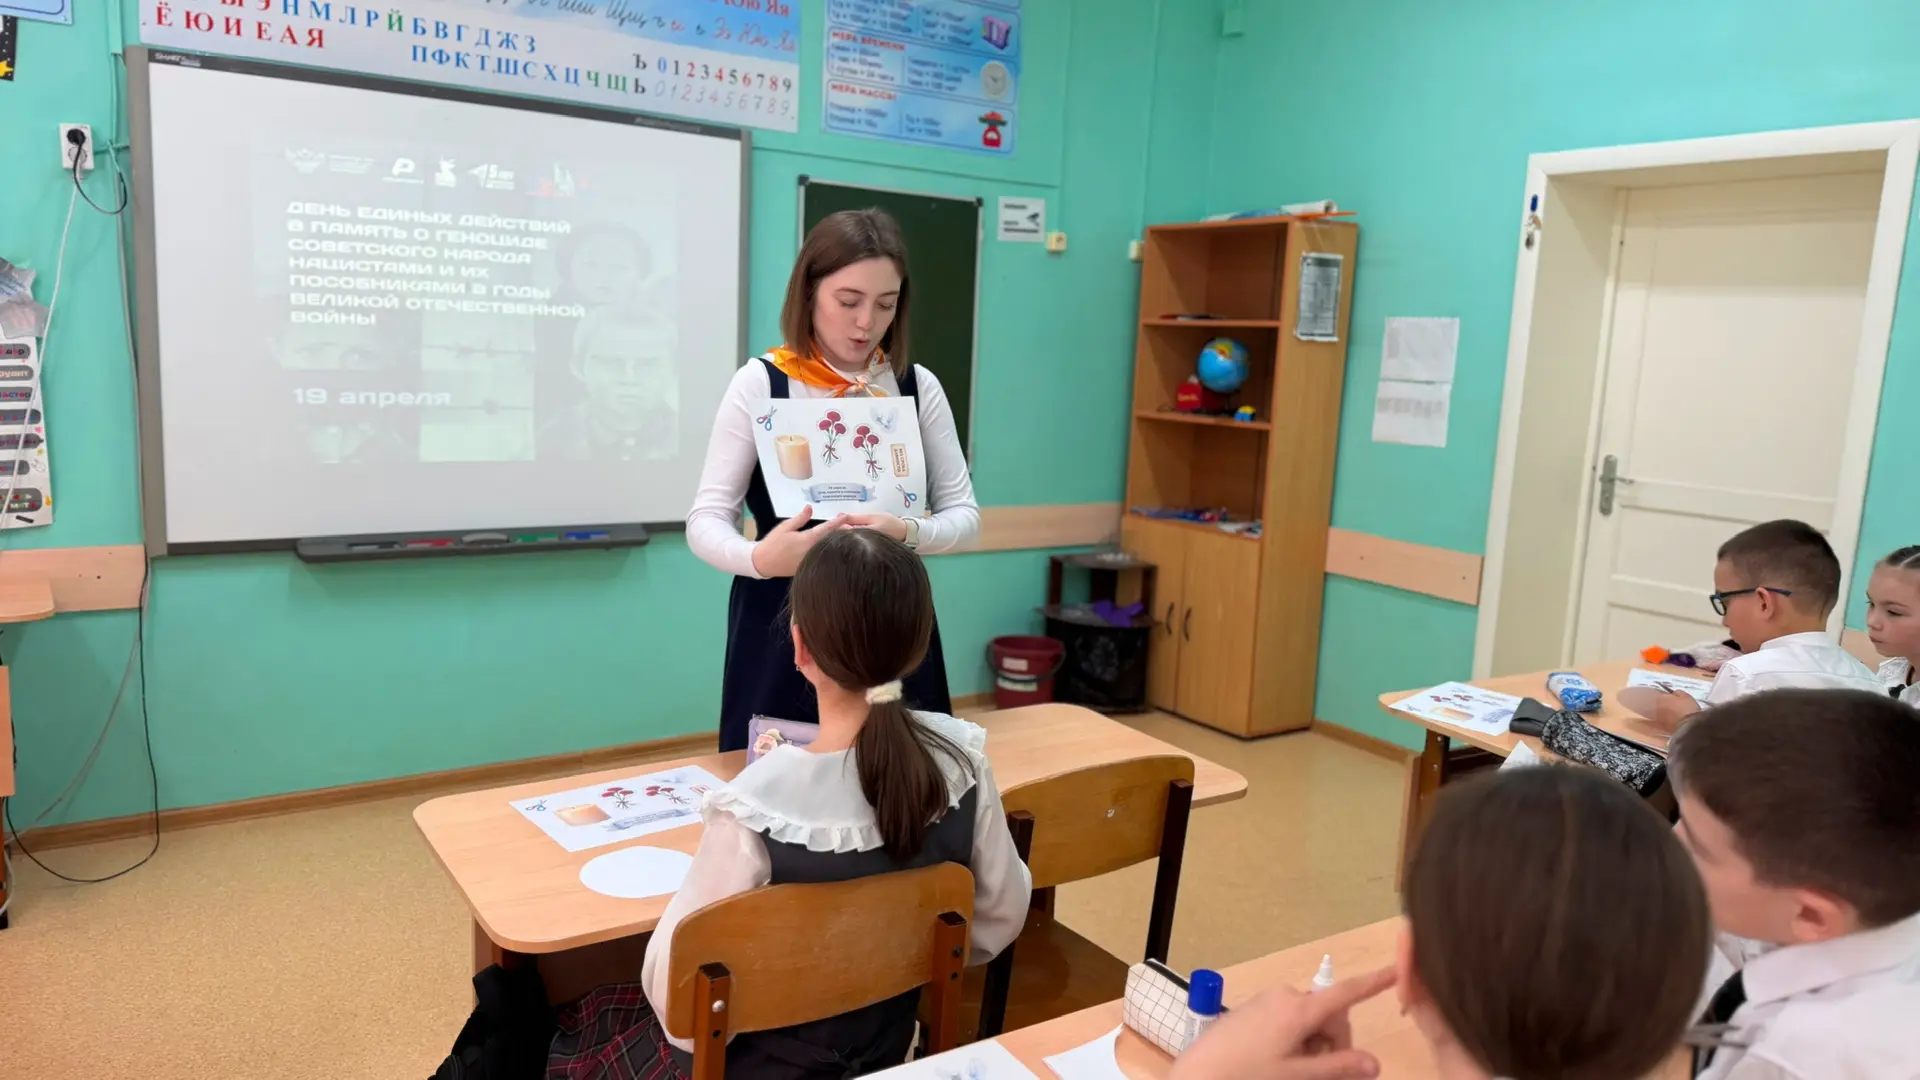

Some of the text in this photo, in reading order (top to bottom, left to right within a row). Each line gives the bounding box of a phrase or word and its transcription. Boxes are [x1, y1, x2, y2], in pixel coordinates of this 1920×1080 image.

[287, 201, 571, 234] ДЕНЬ ЕДИНЫХ ДЕЙСТВИЙ
[287, 219, 549, 249] В ПАМЯТЬ О ГЕНОЦИДЕ
[288, 238, 532, 265] СОВЕТСКОГО НАРОДА
[289, 256, 490, 279] НАЦИСТАМИ И ИХ
[290, 274, 551, 300] ПОСОБНИКАМИ В ГОДЫ
[290, 292, 586, 318] ВЕЛИКОЙ ОТЕЧЕСТВЕННОЙ
[291, 310, 377, 326] ВОЙНЫ
[294, 387, 452, 408] 19 апреля
